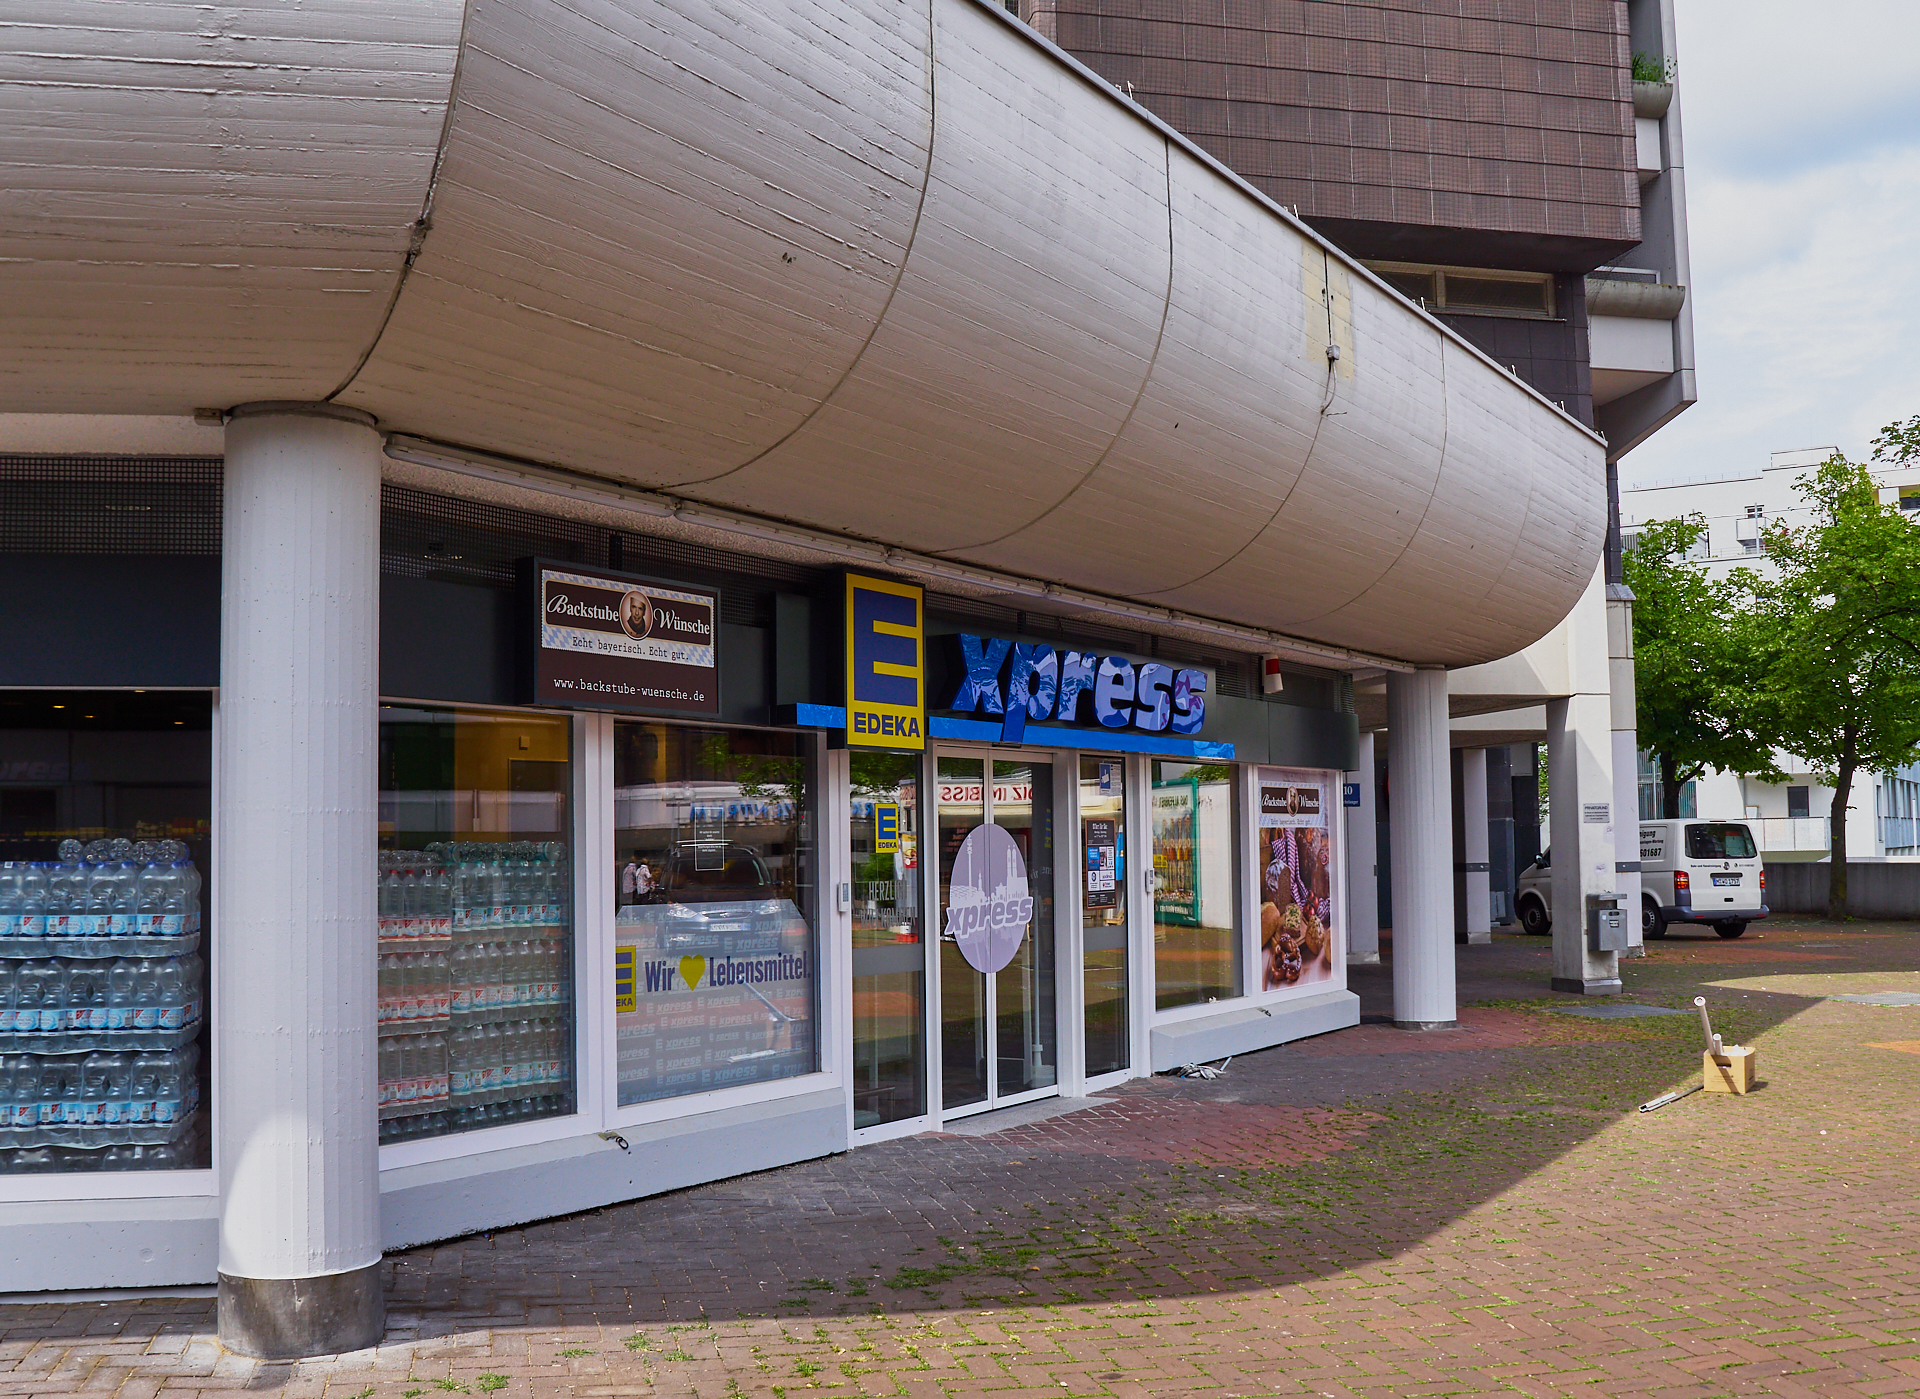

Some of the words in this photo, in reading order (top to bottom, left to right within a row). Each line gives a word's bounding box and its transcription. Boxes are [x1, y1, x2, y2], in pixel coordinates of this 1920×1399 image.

[547, 594, 619, 622] Backstube
[653, 608, 710, 634] Wünsche
[572, 636, 593, 648] Echt
[598, 639, 646, 655] bayerisch.
[649, 646, 668, 658] Echt
[671, 650, 689, 661] gut.
[553, 678, 705, 701] www.backstube-wuensche.de
[951, 633, 1208, 743] xpress
[854, 712, 920, 738] EDEKA
[945, 897, 1033, 938] xpress
[736, 937, 778, 951] xpress
[645, 961, 675, 992] Wir
[709, 950, 811, 986] Lebensmittel.
[656, 1002, 693, 1013] xpress
[707, 996, 740, 1007] xpress
[671, 1015, 705, 1027] xpress
[719, 1014, 752, 1026] xpress
[666, 1036, 701, 1048] xpress
[666, 1056, 701, 1070] xpress
[715, 1065, 757, 1080] xpress
